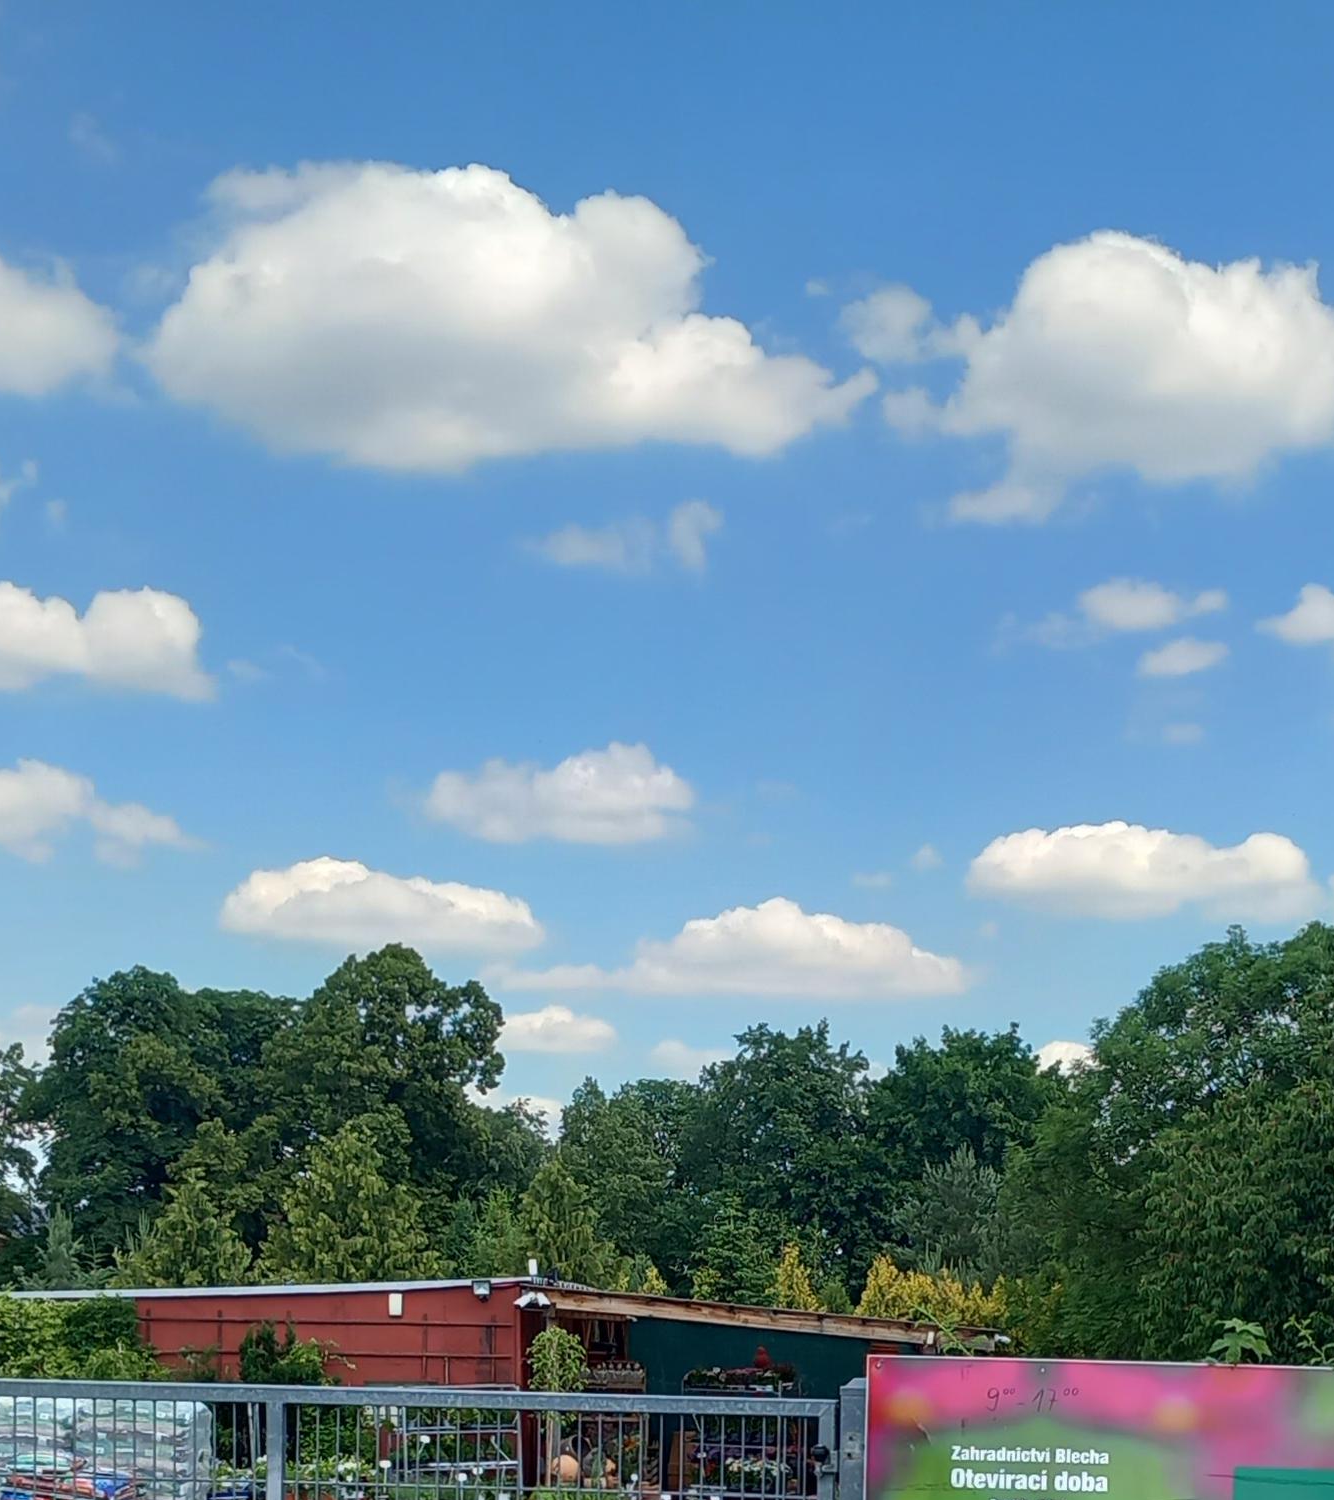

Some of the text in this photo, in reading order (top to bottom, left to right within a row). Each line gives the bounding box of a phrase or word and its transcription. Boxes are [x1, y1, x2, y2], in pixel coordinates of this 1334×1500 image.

[951, 1445, 1110, 1465] Zahradnictví Blecha
[950, 1468, 1109, 1492] Otevírací doba
